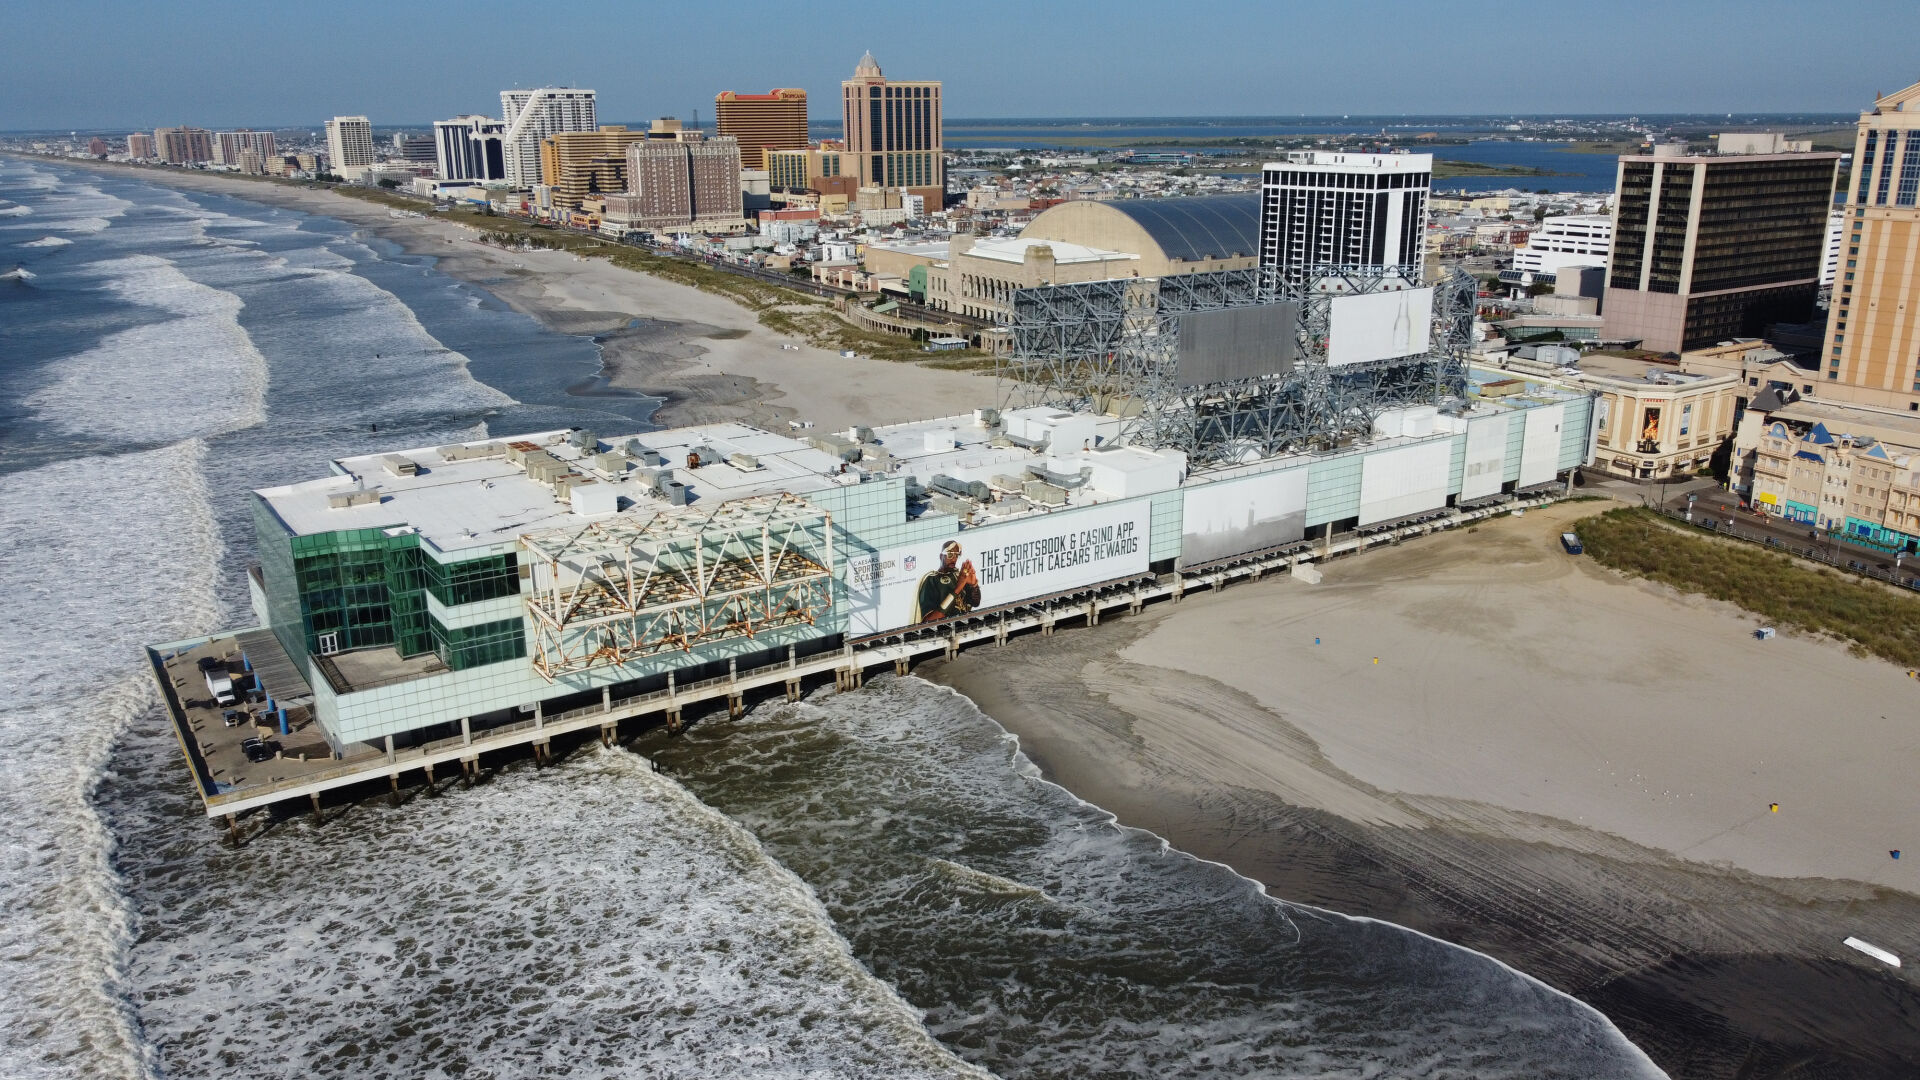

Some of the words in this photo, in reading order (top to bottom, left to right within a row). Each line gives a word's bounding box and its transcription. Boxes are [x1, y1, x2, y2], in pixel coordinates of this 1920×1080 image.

[980, 549, 1000, 568] THE
[1004, 535, 1066, 563] SPORTSBOOK
[1070, 533, 1077, 550] &
[1080, 525, 1113, 548] CASINO
[1116, 521, 1134, 540] APP
[853, 560, 896, 575] SPORTSBOOK
[854, 558, 879, 566] CAESARS
[980, 564, 1006, 585] THAT
[1009, 556, 1044, 579] GIVETH
[1047, 547, 1091, 571] CAESARS
[1094, 536, 1138, 561] REWARDS
